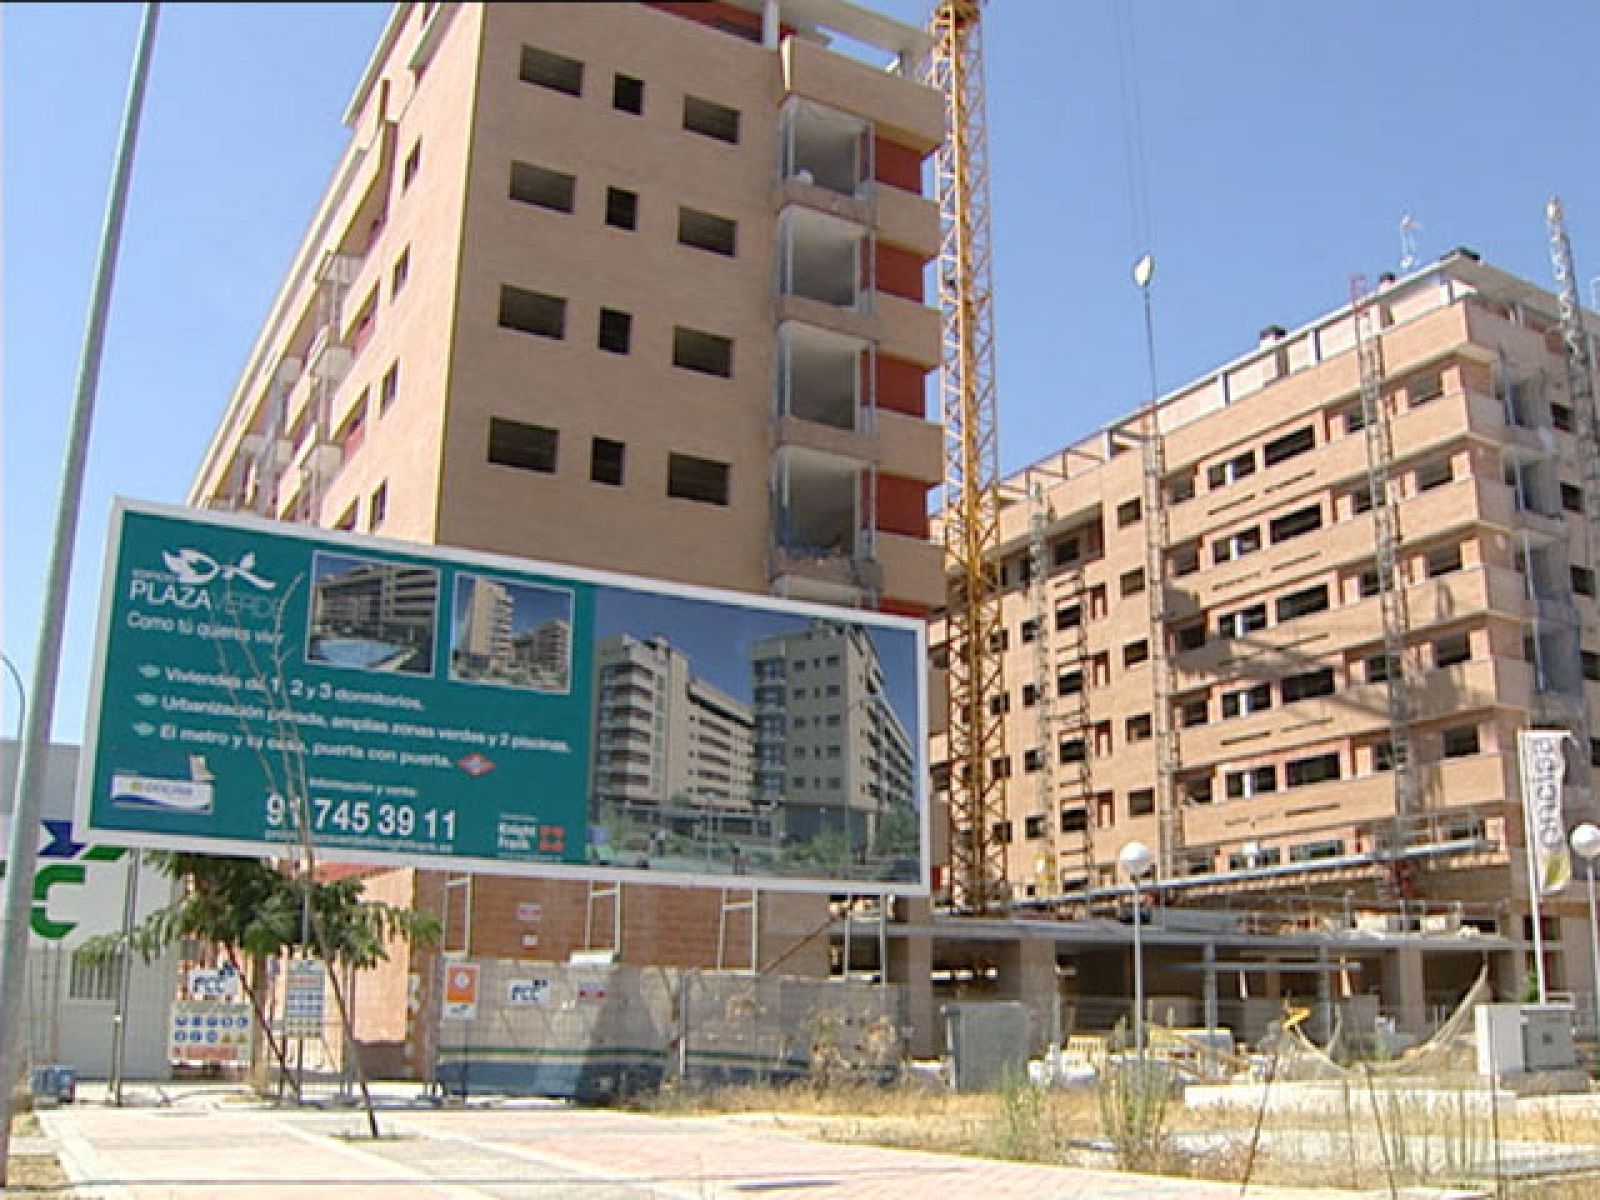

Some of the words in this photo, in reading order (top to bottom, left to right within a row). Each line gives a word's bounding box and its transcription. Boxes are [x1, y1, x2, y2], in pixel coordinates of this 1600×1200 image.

[130, 580, 211, 610] PLAZA
[213, 591, 281, 617] VERD
[127, 610, 175, 632] Como
[289, 679, 304, 697] 2
[306, 685, 316, 700] y
[319, 681, 333, 699] 3
[232, 734, 242, 749] y
[313, 799, 371, 834] 745
[377, 803, 416, 837] 39
[424, 809, 456, 841] 11
